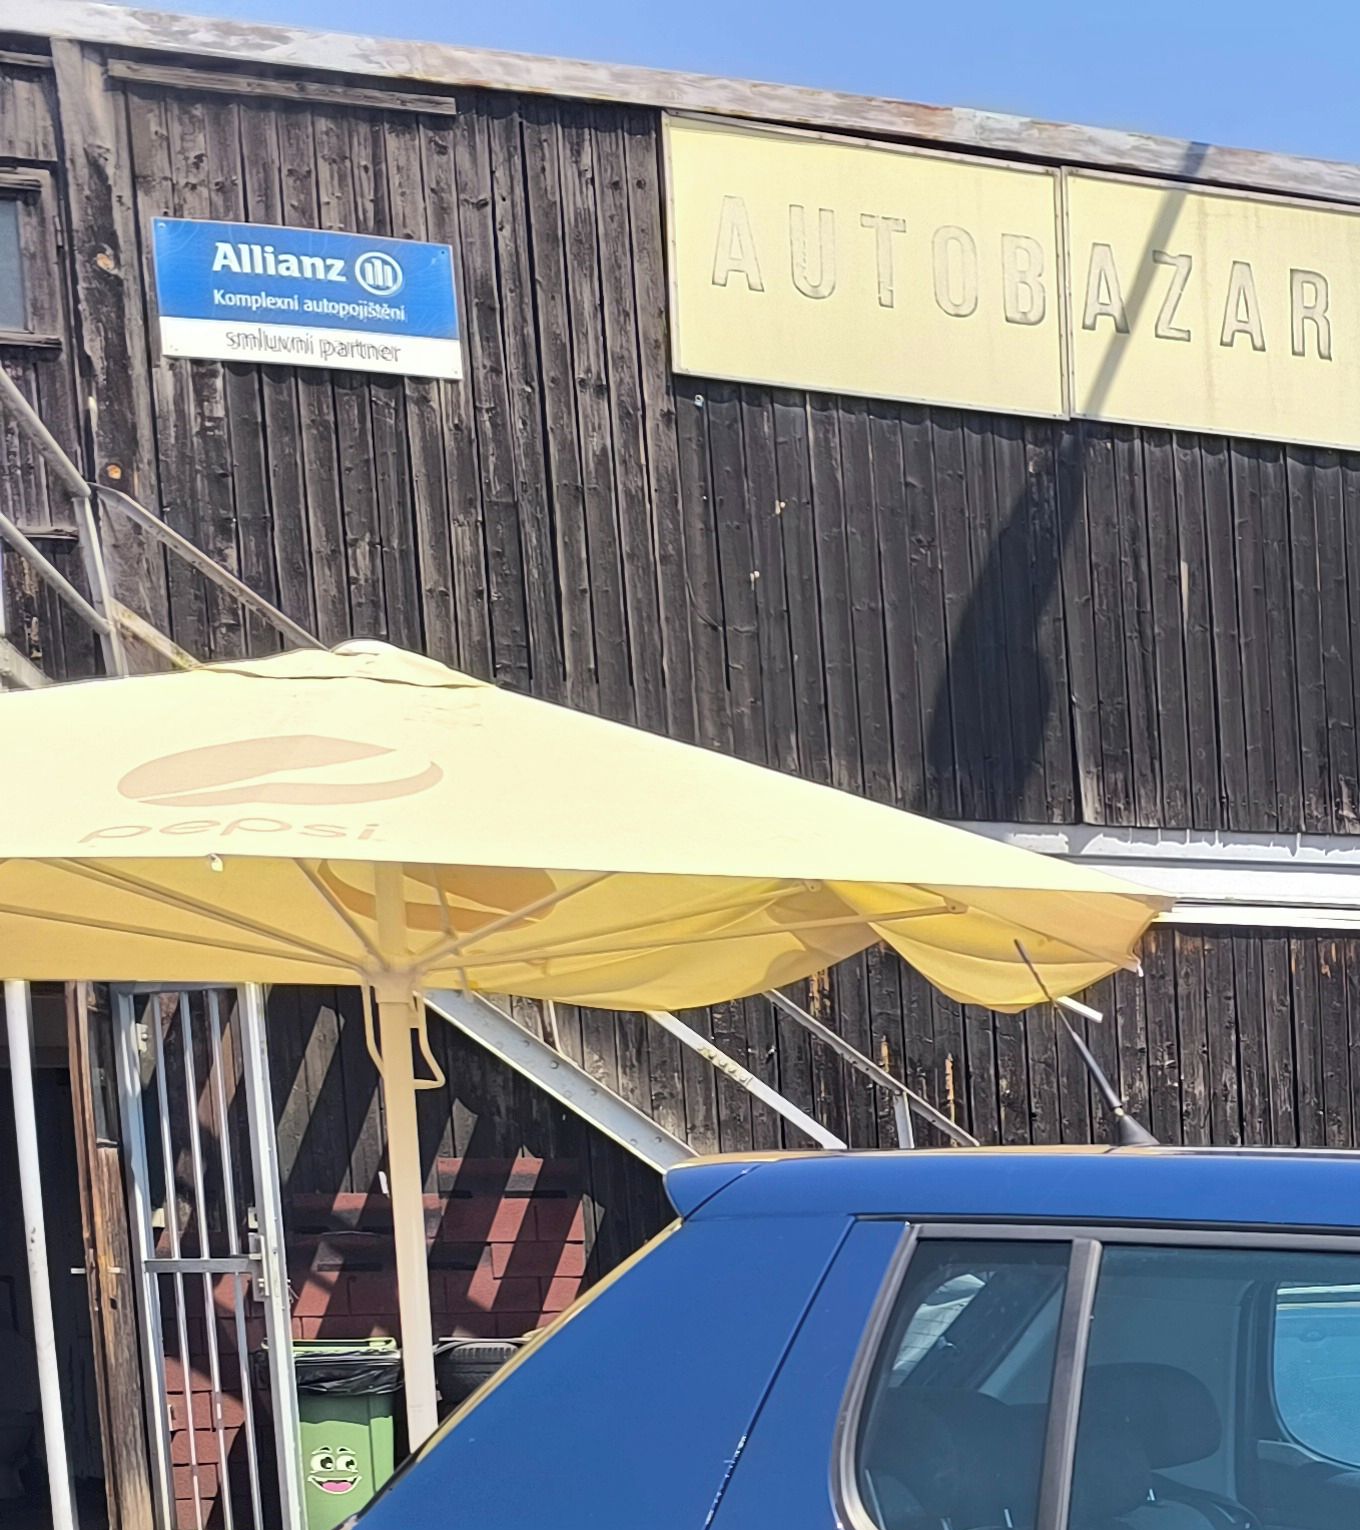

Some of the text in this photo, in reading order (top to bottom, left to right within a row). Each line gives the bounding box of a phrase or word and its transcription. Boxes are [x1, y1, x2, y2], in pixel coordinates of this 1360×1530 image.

[212, 242, 347, 282] Allianz
[710, 194, 1333, 362] AUTOBAZAR
[303, 299, 406, 321] autopojištění
[319, 336, 401, 363] partner
[78, 817, 382, 844] pepsi
